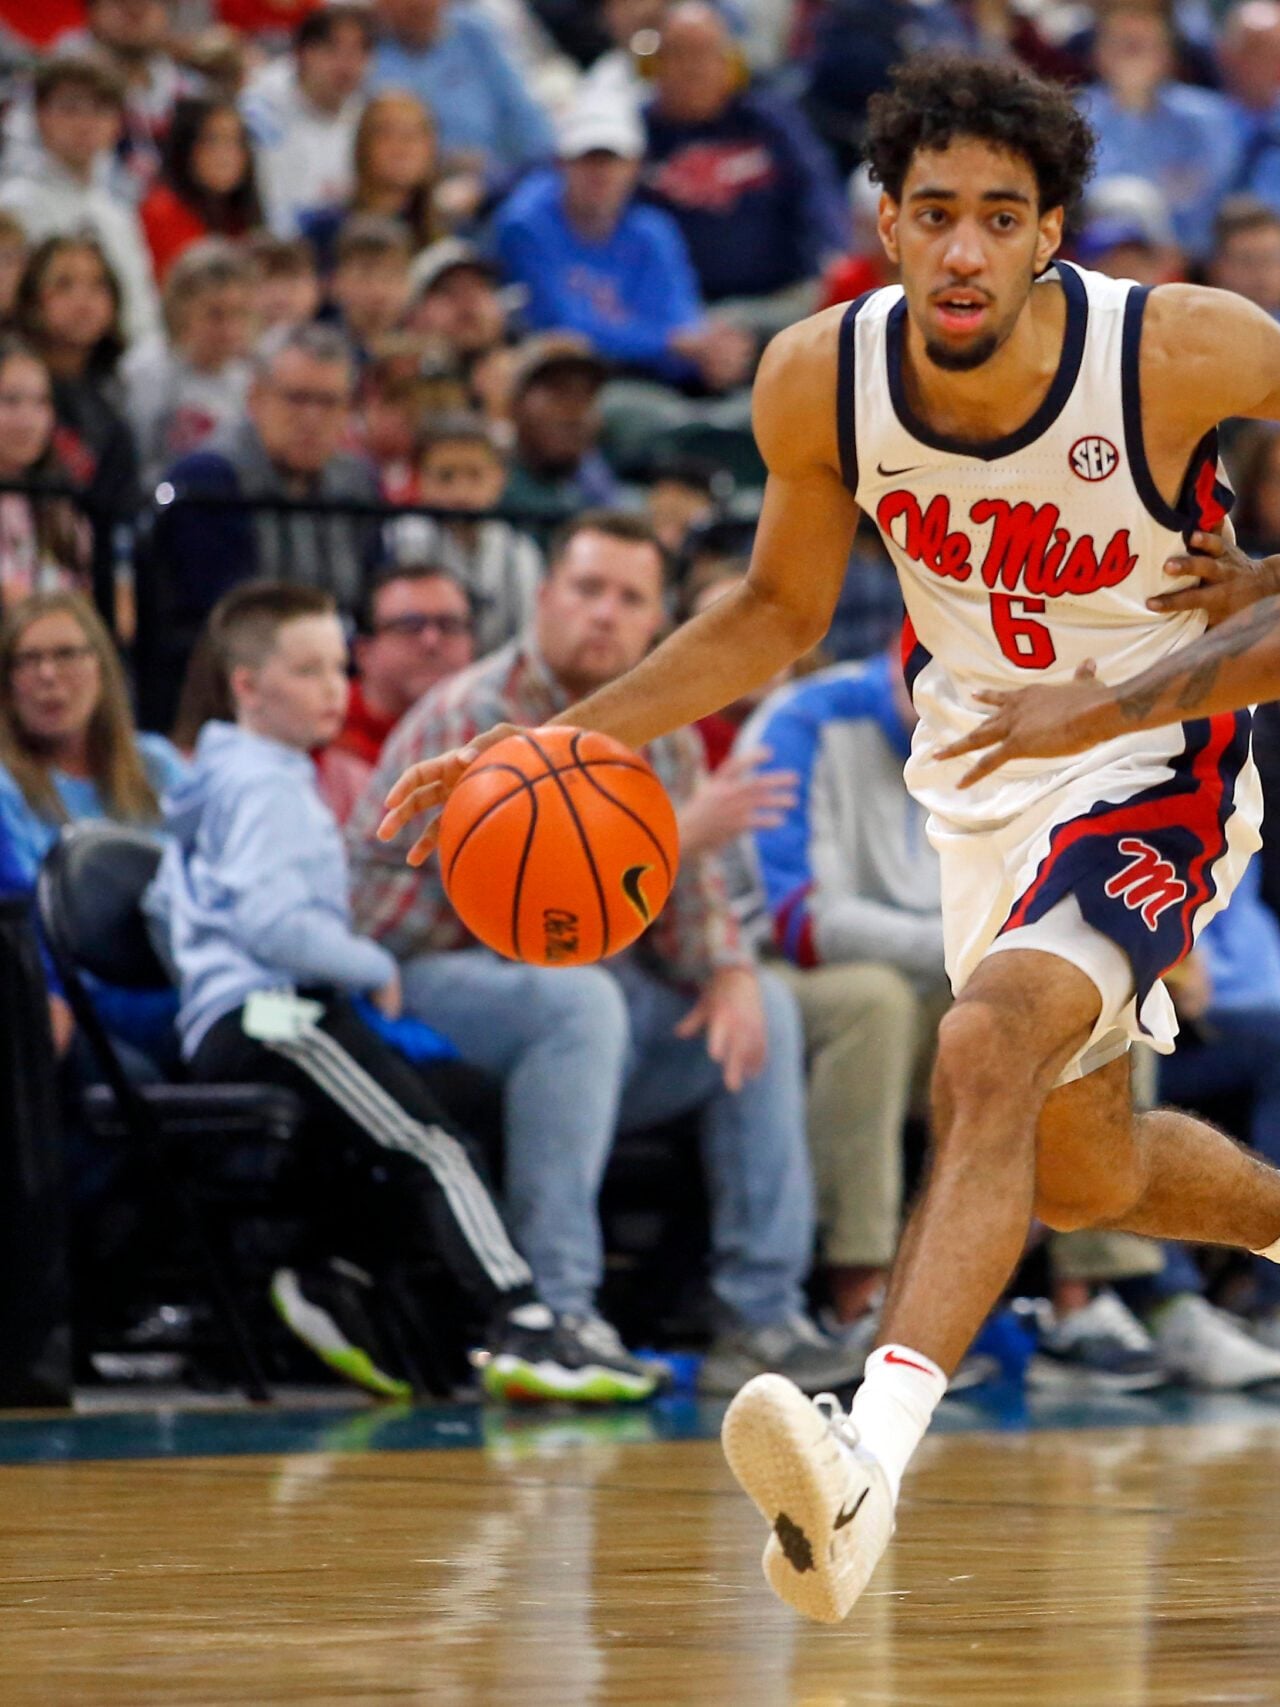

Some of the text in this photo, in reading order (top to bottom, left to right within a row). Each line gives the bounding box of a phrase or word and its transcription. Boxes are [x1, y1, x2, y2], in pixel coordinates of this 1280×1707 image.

[1071, 439, 1117, 479] SEC
[876, 489, 1138, 597] Ole Miss
[989, 592, 1056, 669] 6
